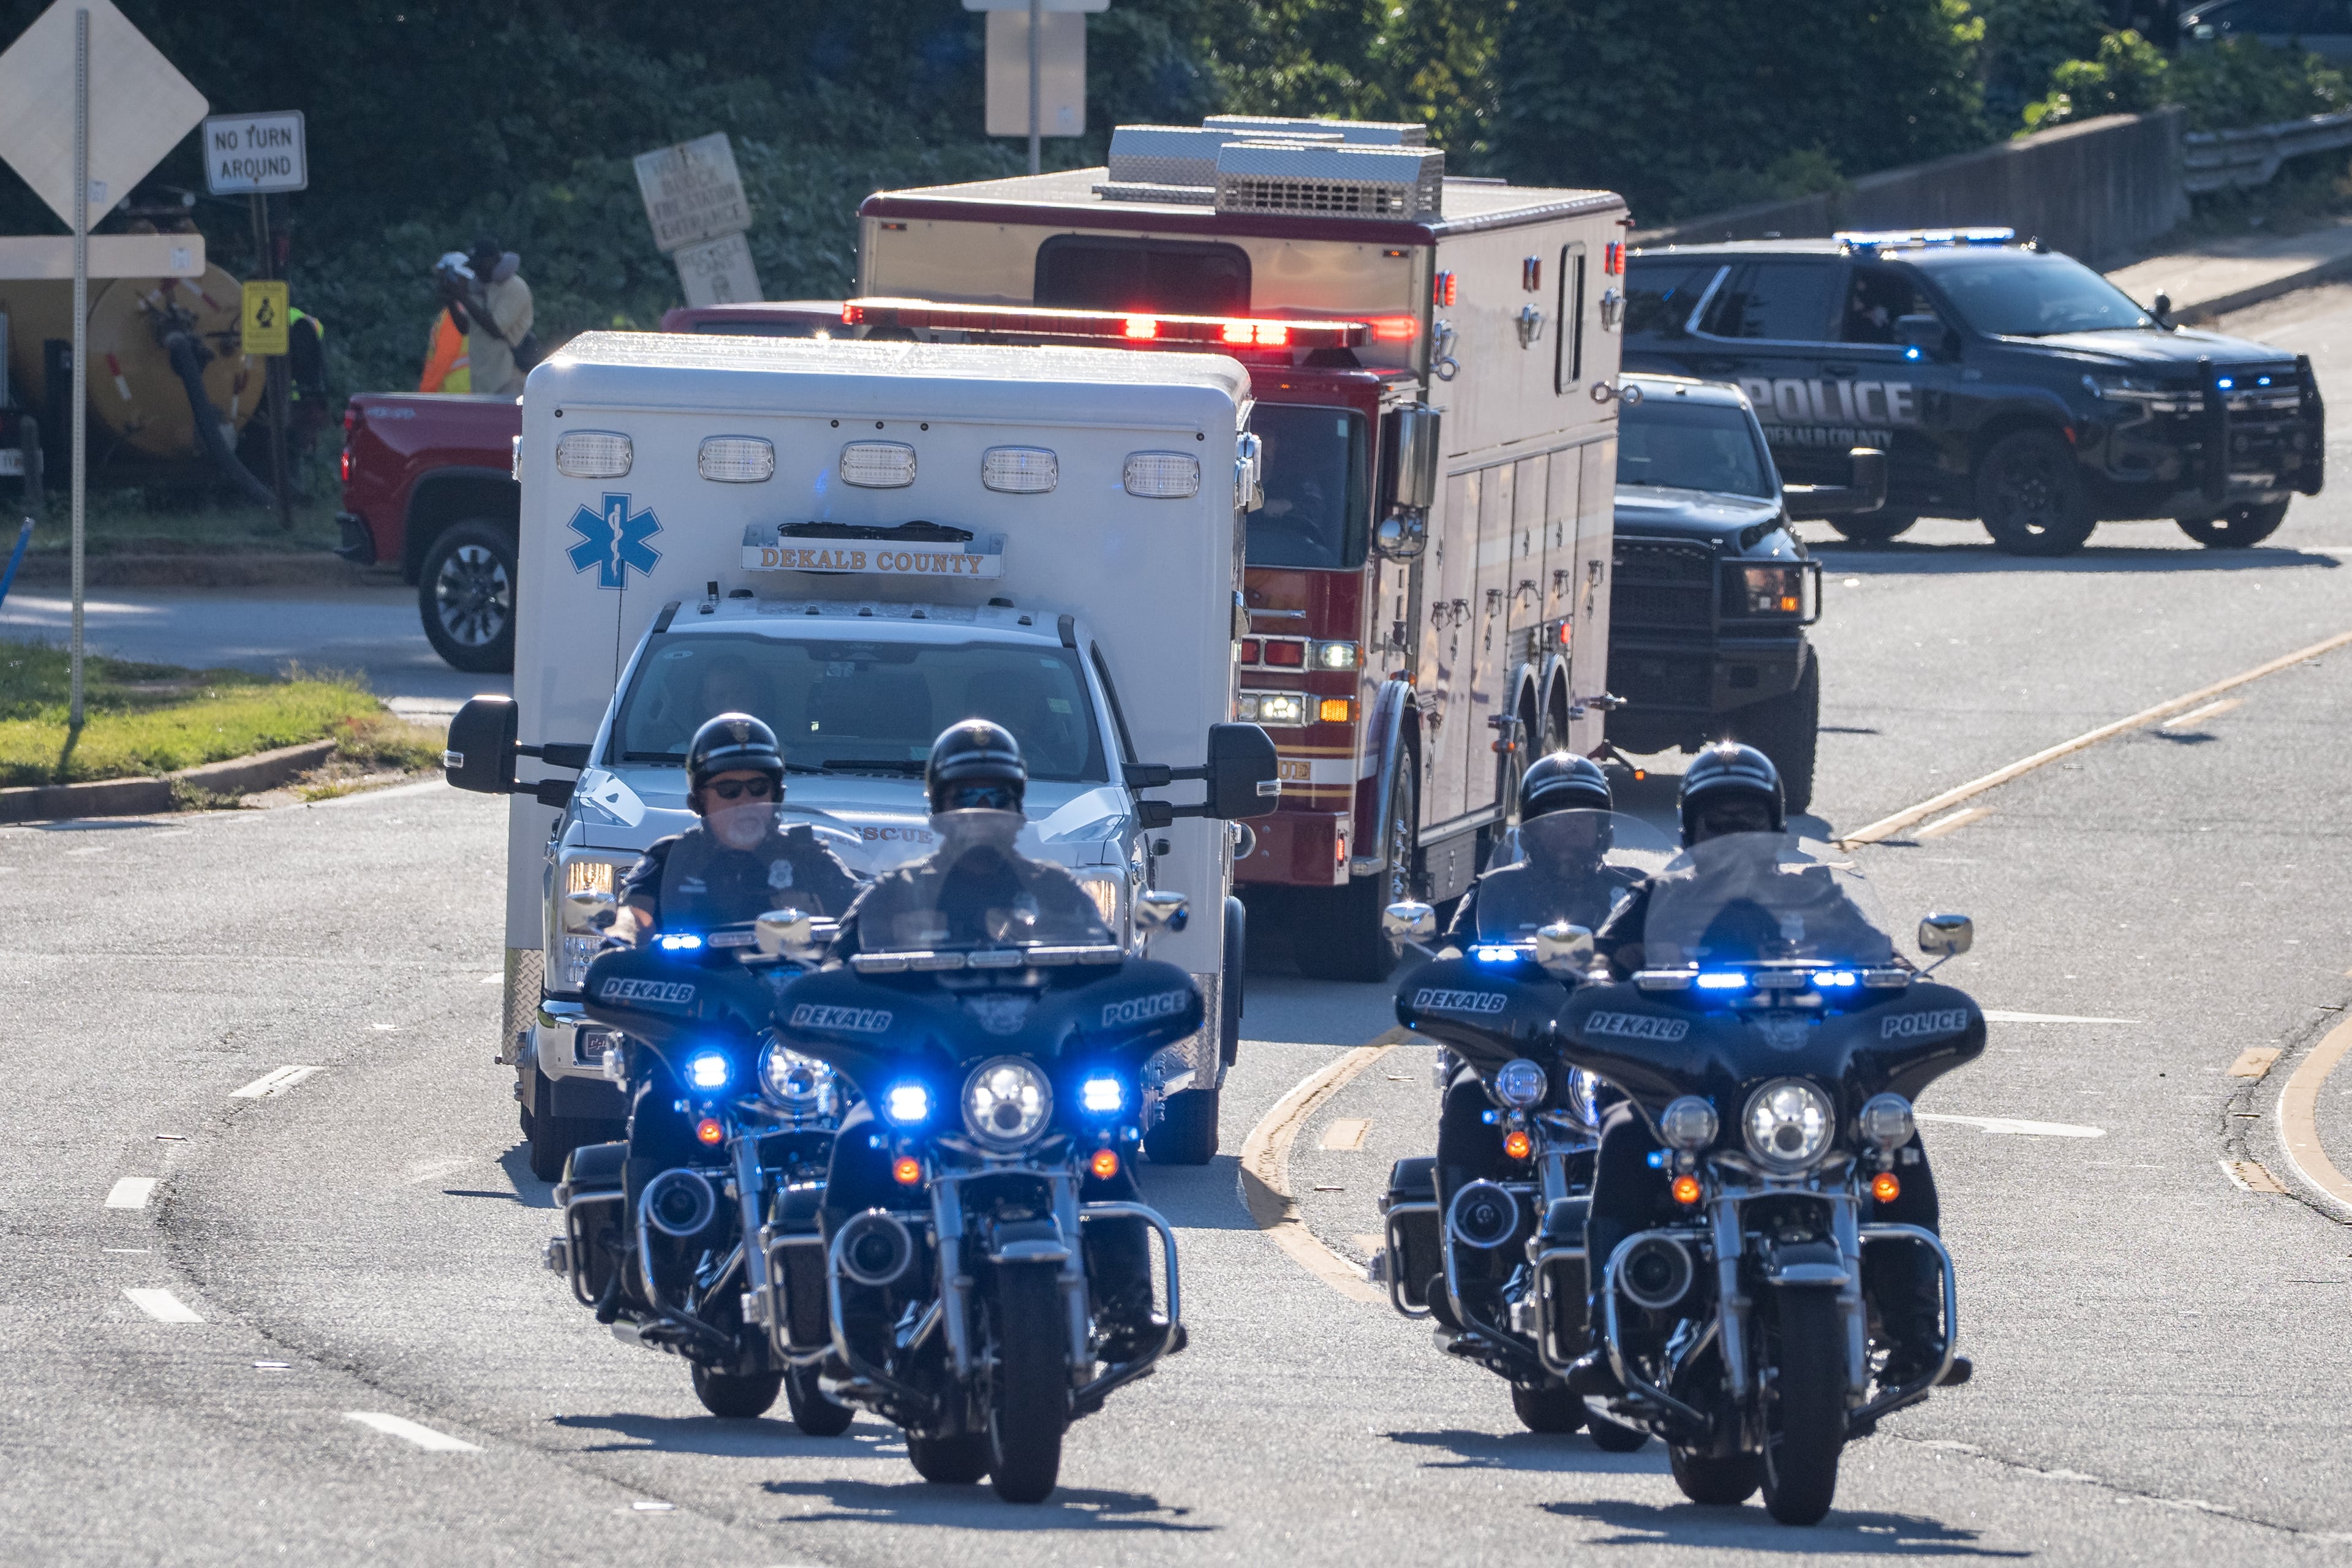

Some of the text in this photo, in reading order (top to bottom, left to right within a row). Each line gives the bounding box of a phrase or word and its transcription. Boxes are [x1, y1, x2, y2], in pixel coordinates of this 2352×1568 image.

[216, 127, 292, 150] NO TURN
[222, 156, 291, 179] AROUND
[684, 181, 738, 211] STATION
[659, 202, 744, 241] ENTRANCE
[1739, 377, 1918, 424] POLICE
[1828, 428, 1893, 448] COUNTY
[761, 548, 984, 574] DEKALB COUNTY
[852, 827, 933, 844] SCUE
[600, 978, 696, 1003] DEKALB
[1412, 989, 1507, 1013] DEKALB
[790, 989, 1187, 1033] DEKALB POLICE
[1585, 1009, 1968, 1041] DEKALB POLICE
